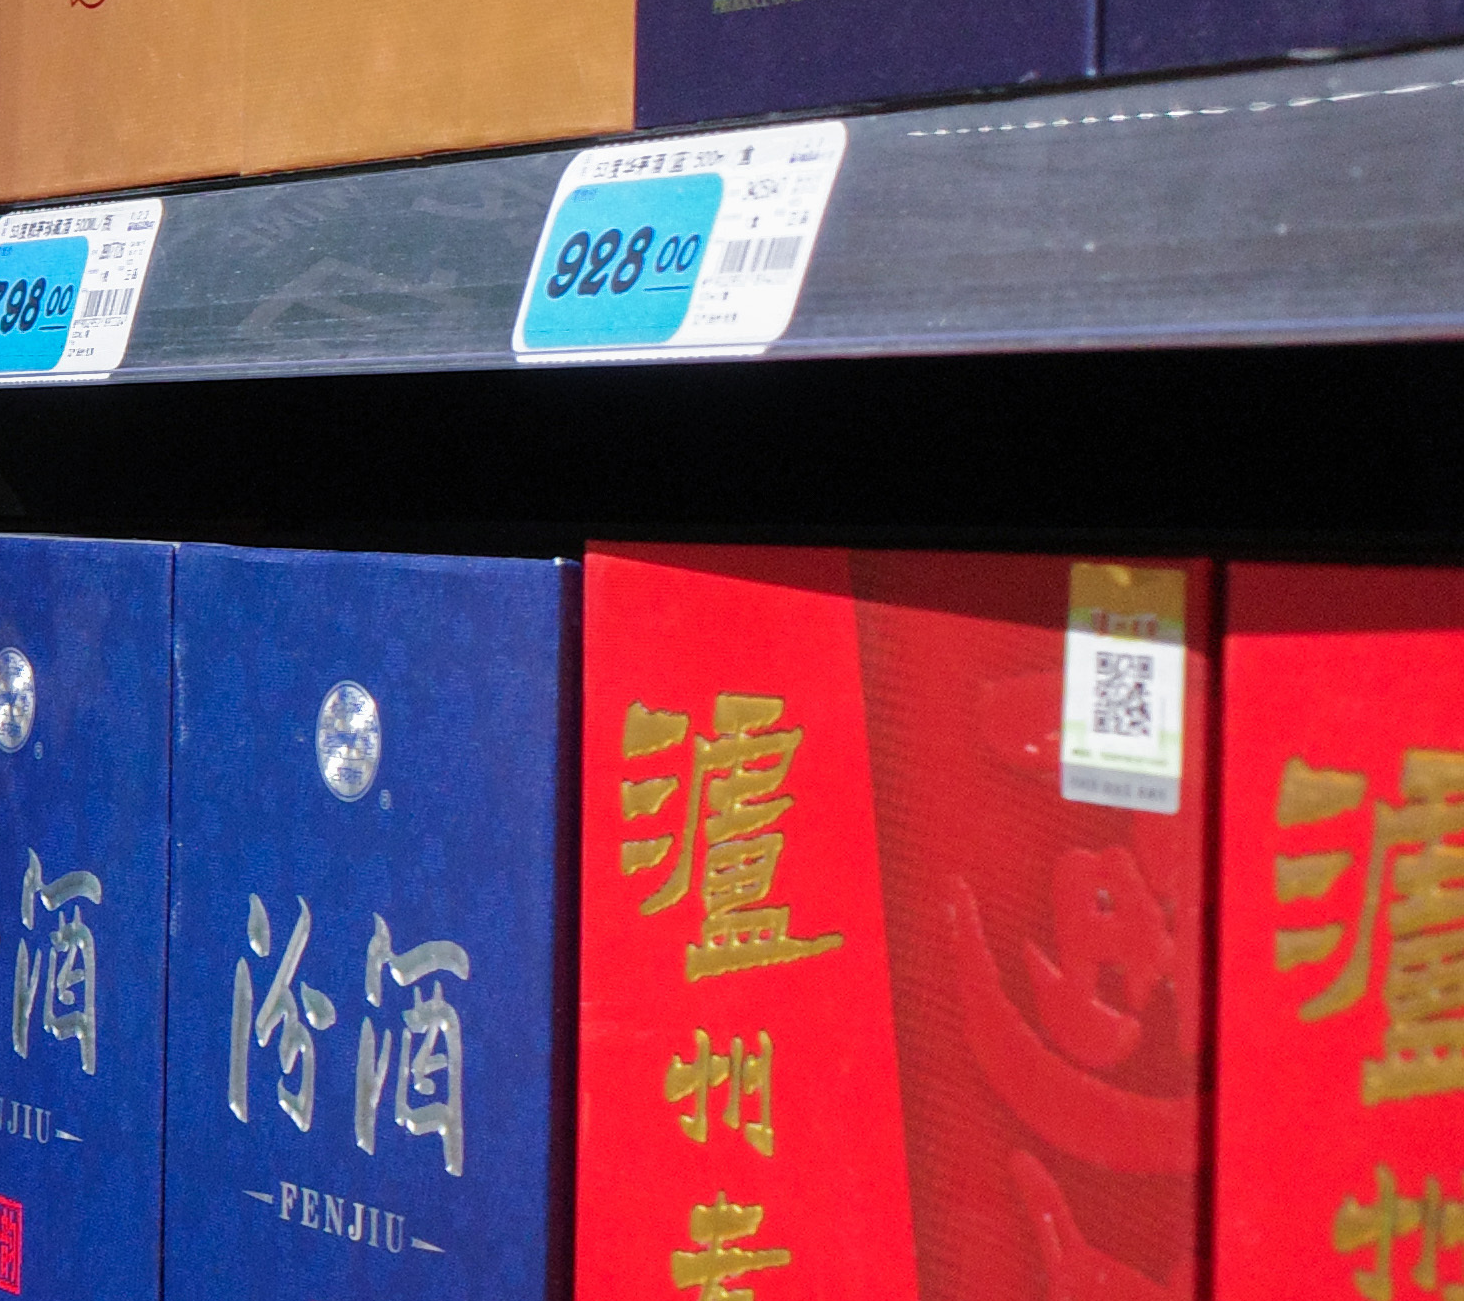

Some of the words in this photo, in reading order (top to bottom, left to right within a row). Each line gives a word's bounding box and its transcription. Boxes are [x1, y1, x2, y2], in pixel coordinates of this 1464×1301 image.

[546, 226, 654, 299] 928
[227, 891, 470, 1177] 汾酒
[278, 1181, 406, 1254] FENJIU
